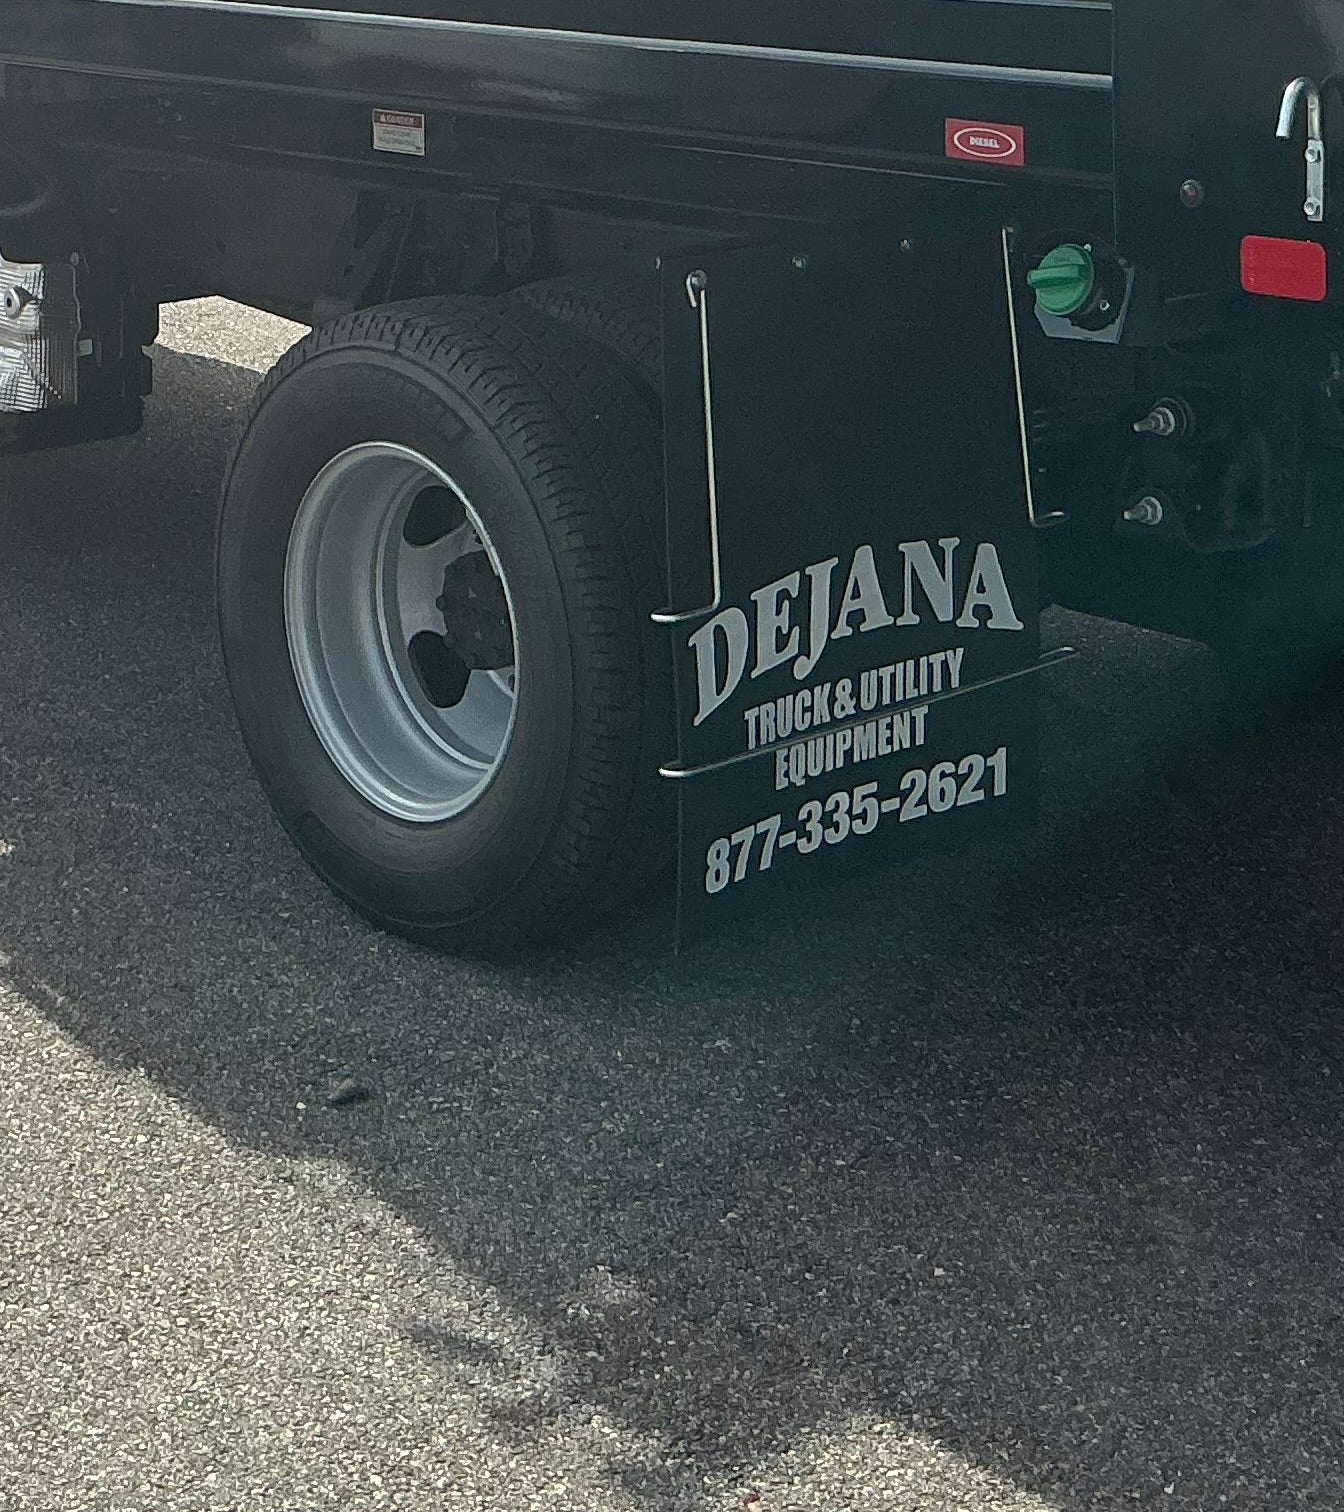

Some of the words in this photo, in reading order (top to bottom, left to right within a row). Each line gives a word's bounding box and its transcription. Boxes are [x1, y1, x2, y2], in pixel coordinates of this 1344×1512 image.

[969, 135, 1000, 149] DIESEL
[688, 537, 1024, 727] DEJANA
[775, 705, 929, 791] EQUIPMENT
[706, 746, 1007, 894] 877-335-2621
